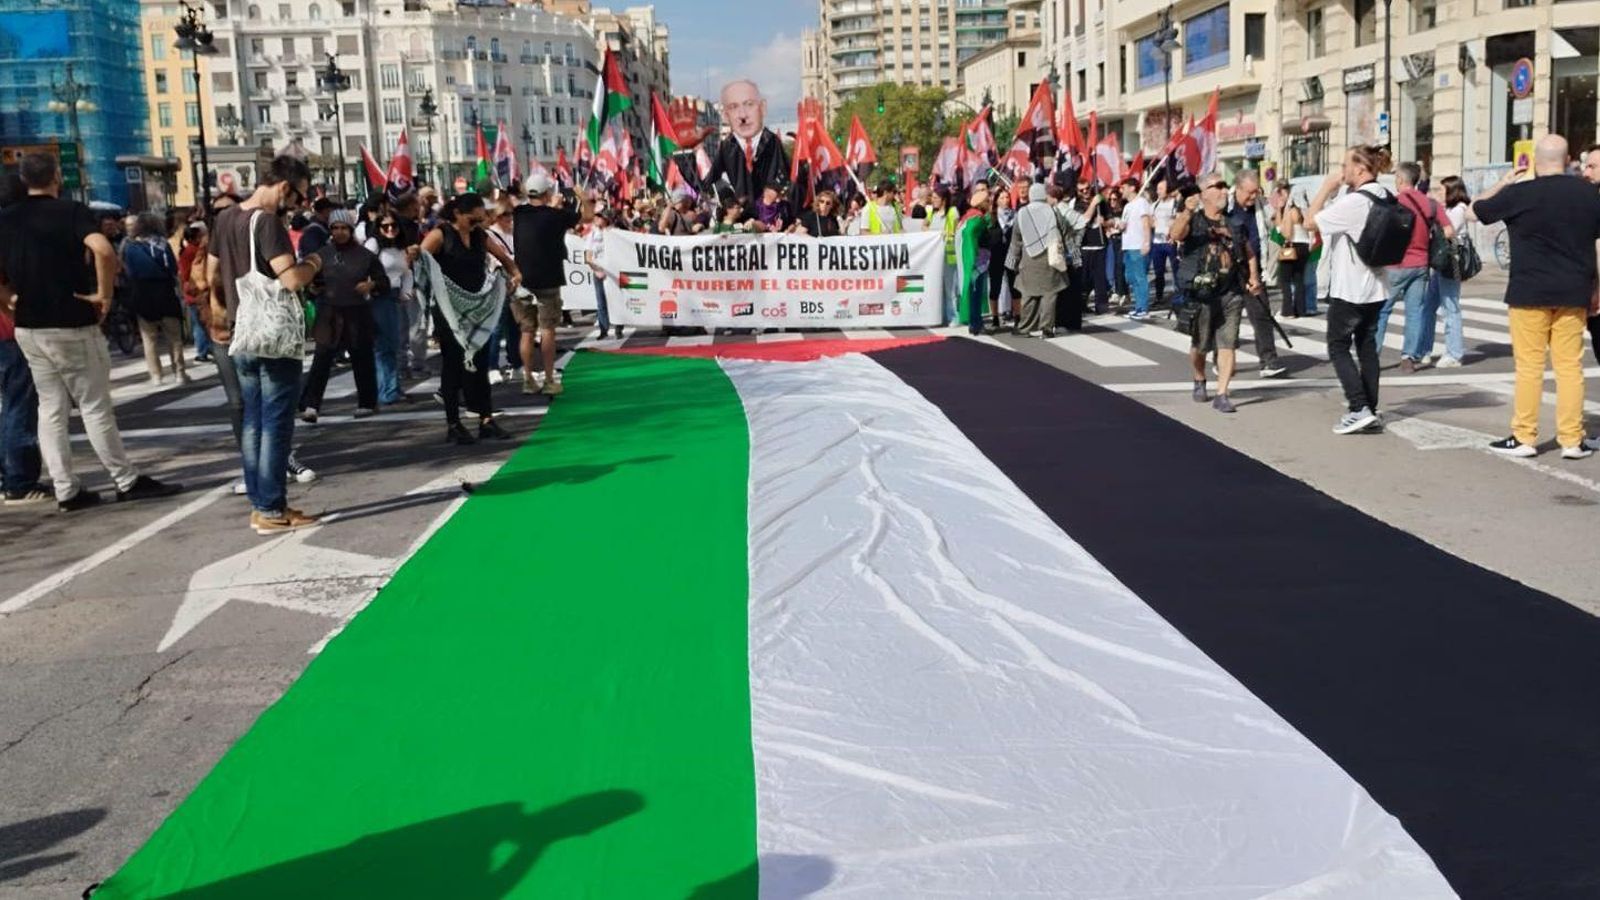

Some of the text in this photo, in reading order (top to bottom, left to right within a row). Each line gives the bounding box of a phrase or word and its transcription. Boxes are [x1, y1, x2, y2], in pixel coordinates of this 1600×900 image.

[635, 243, 683, 271] VAGA
[692, 243, 769, 272] GENERAL
[777, 243, 808, 270] PER
[818, 243, 910, 271] PALESTINA
[671, 276, 884, 291] ATUREM EL GENOCIDI
[761, 307, 788, 318] COS
[800, 301, 825, 314] BDS
